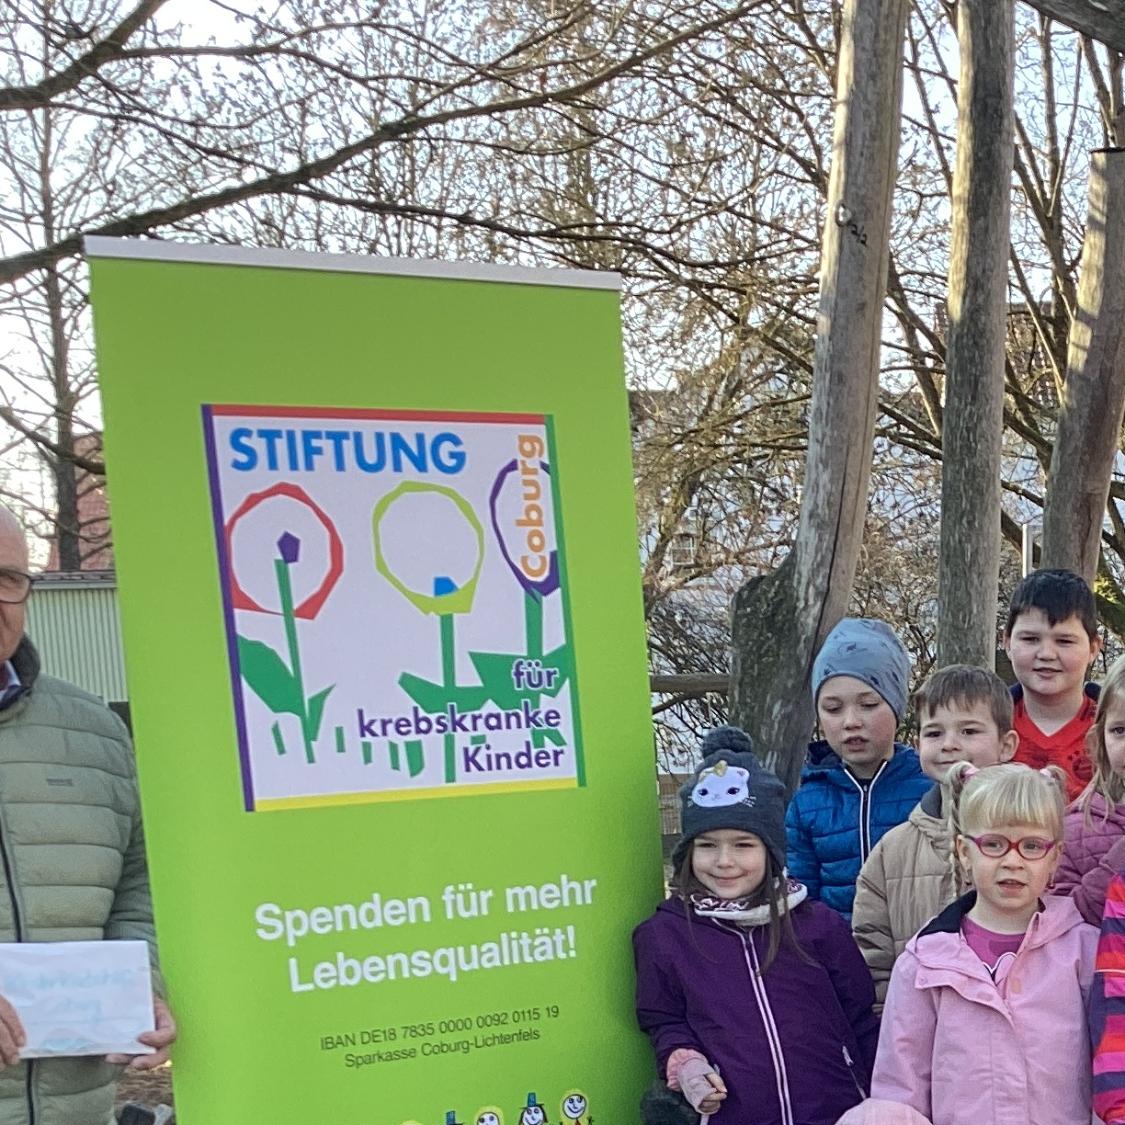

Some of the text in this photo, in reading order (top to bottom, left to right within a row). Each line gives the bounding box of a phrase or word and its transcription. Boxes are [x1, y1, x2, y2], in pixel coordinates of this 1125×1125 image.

[229, 427, 467, 475] STIFTUNG
[515, 433, 545, 578] Coburg
[513, 660, 558, 688] für
[357, 700, 562, 738] krebskranke
[463, 741, 565, 773] Kinder
[255, 874, 598, 947] Spenden für mehr
[288, 925, 577, 992] Lebensqualität!
[320, 1005, 560, 1050] IBAN DE18 7835 0000 0092 0115 19
[345, 1028, 541, 1068] Sparkasse Coburg-Lichtenfels
